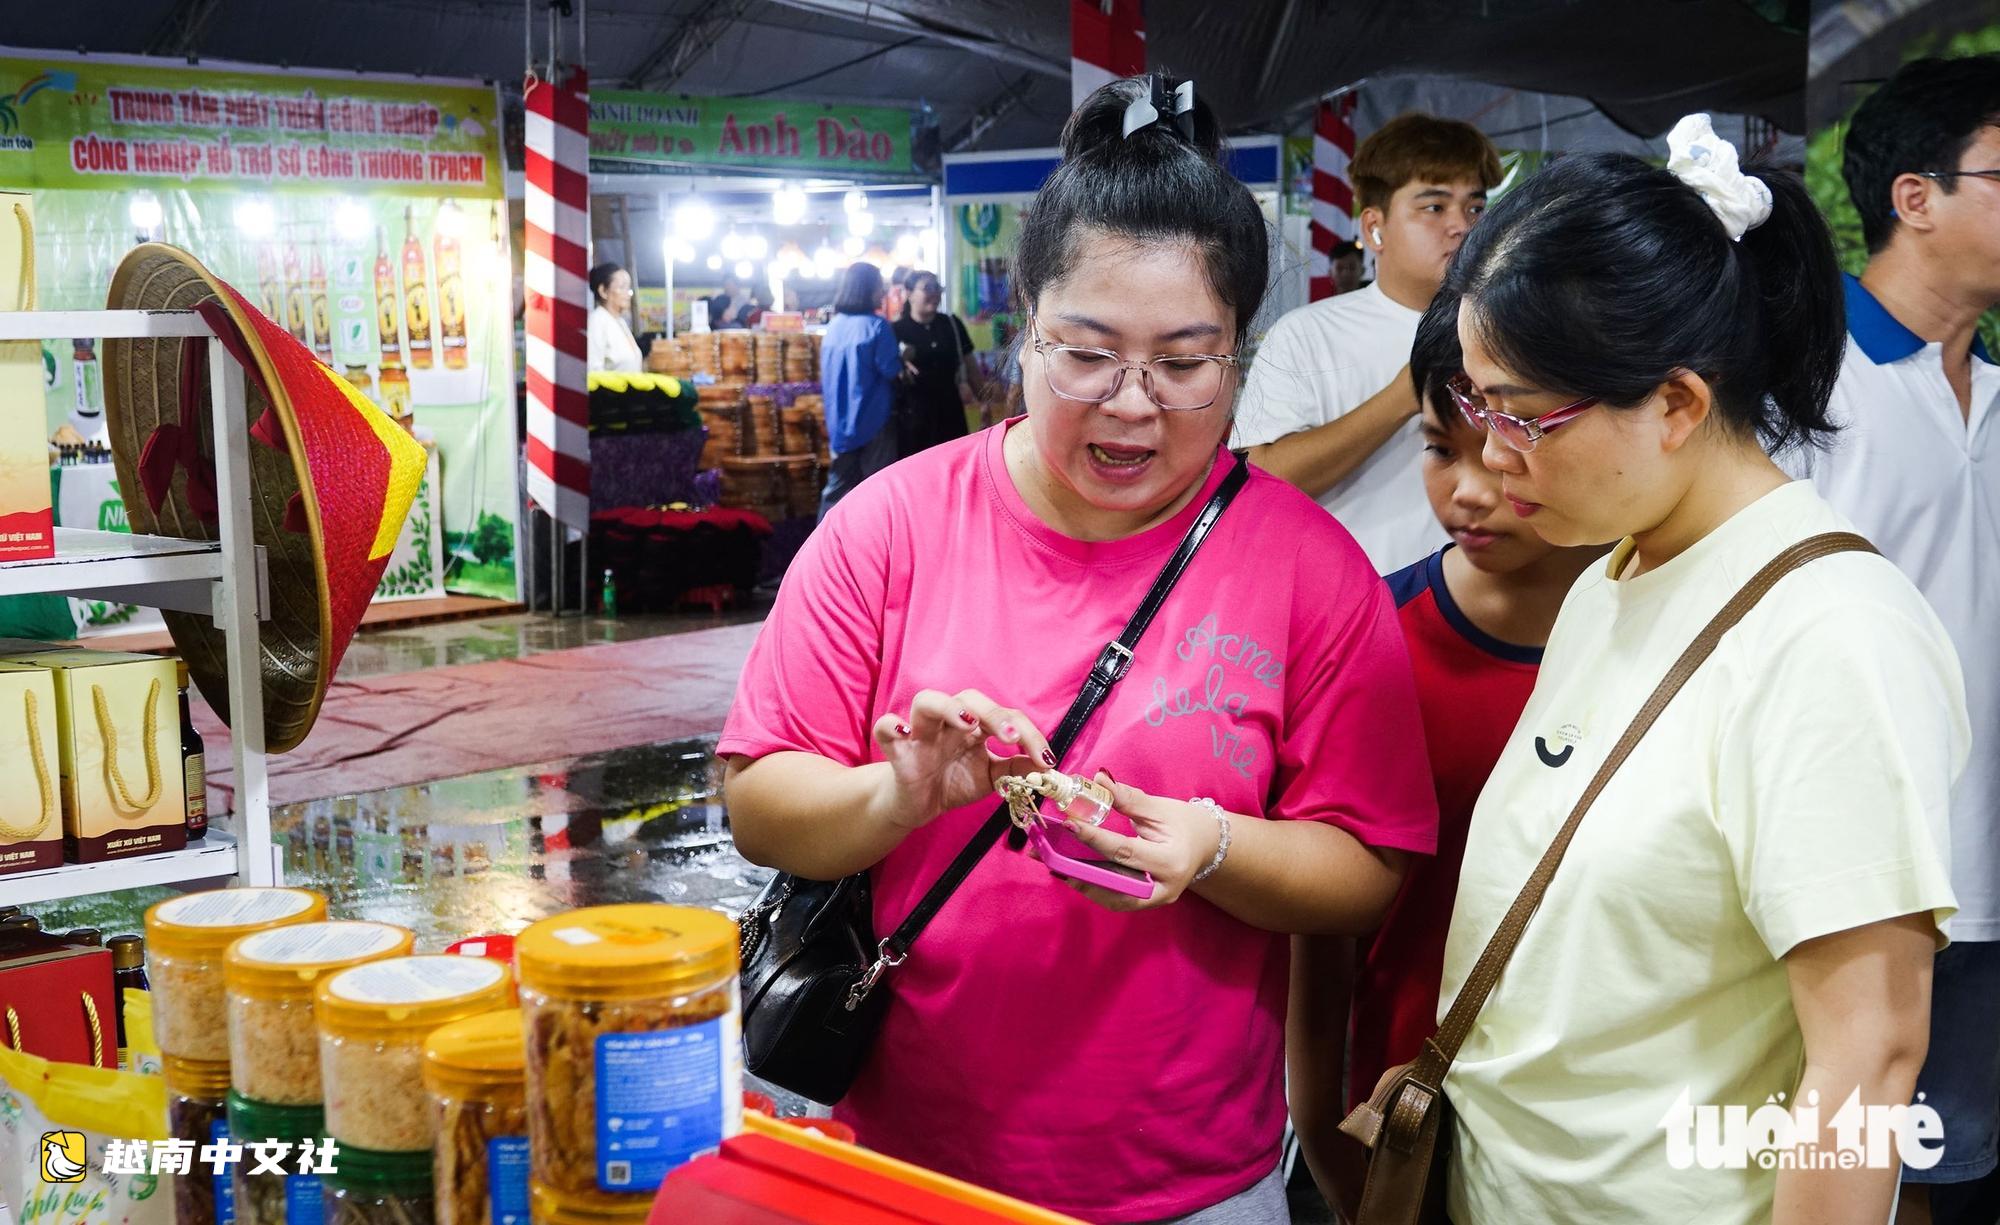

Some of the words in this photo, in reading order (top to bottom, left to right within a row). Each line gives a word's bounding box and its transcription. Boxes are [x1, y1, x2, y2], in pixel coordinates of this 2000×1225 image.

[109, 89, 175, 122] TRUNG
[178, 88, 220, 125] TÂM
[224, 91, 269, 128] PHÁT
[329, 97, 376, 133] CÔNG
[380, 101, 439, 138] NGHIỆP
[73, 135, 129, 171] CÔNG
[133, 138, 201, 179] NGHIỆP
[237, 142, 273, 181] TRỢ
[306, 145, 353, 178] CÔNG
[357, 149, 423, 181] THƯƠNG
[428, 154, 484, 183] TPHCM
[816, 116, 894, 163] Đào
[8, 531, 24, 542] VIỆT
[25, 532, 43, 541] NAM
[1176, 613, 1284, 689] Acme
[1211, 724, 1257, 778] vie
[20, 850, 36, 860] NAM
[133, 836, 146, 845] VIỆT
[147, 834, 162, 843] NAM
